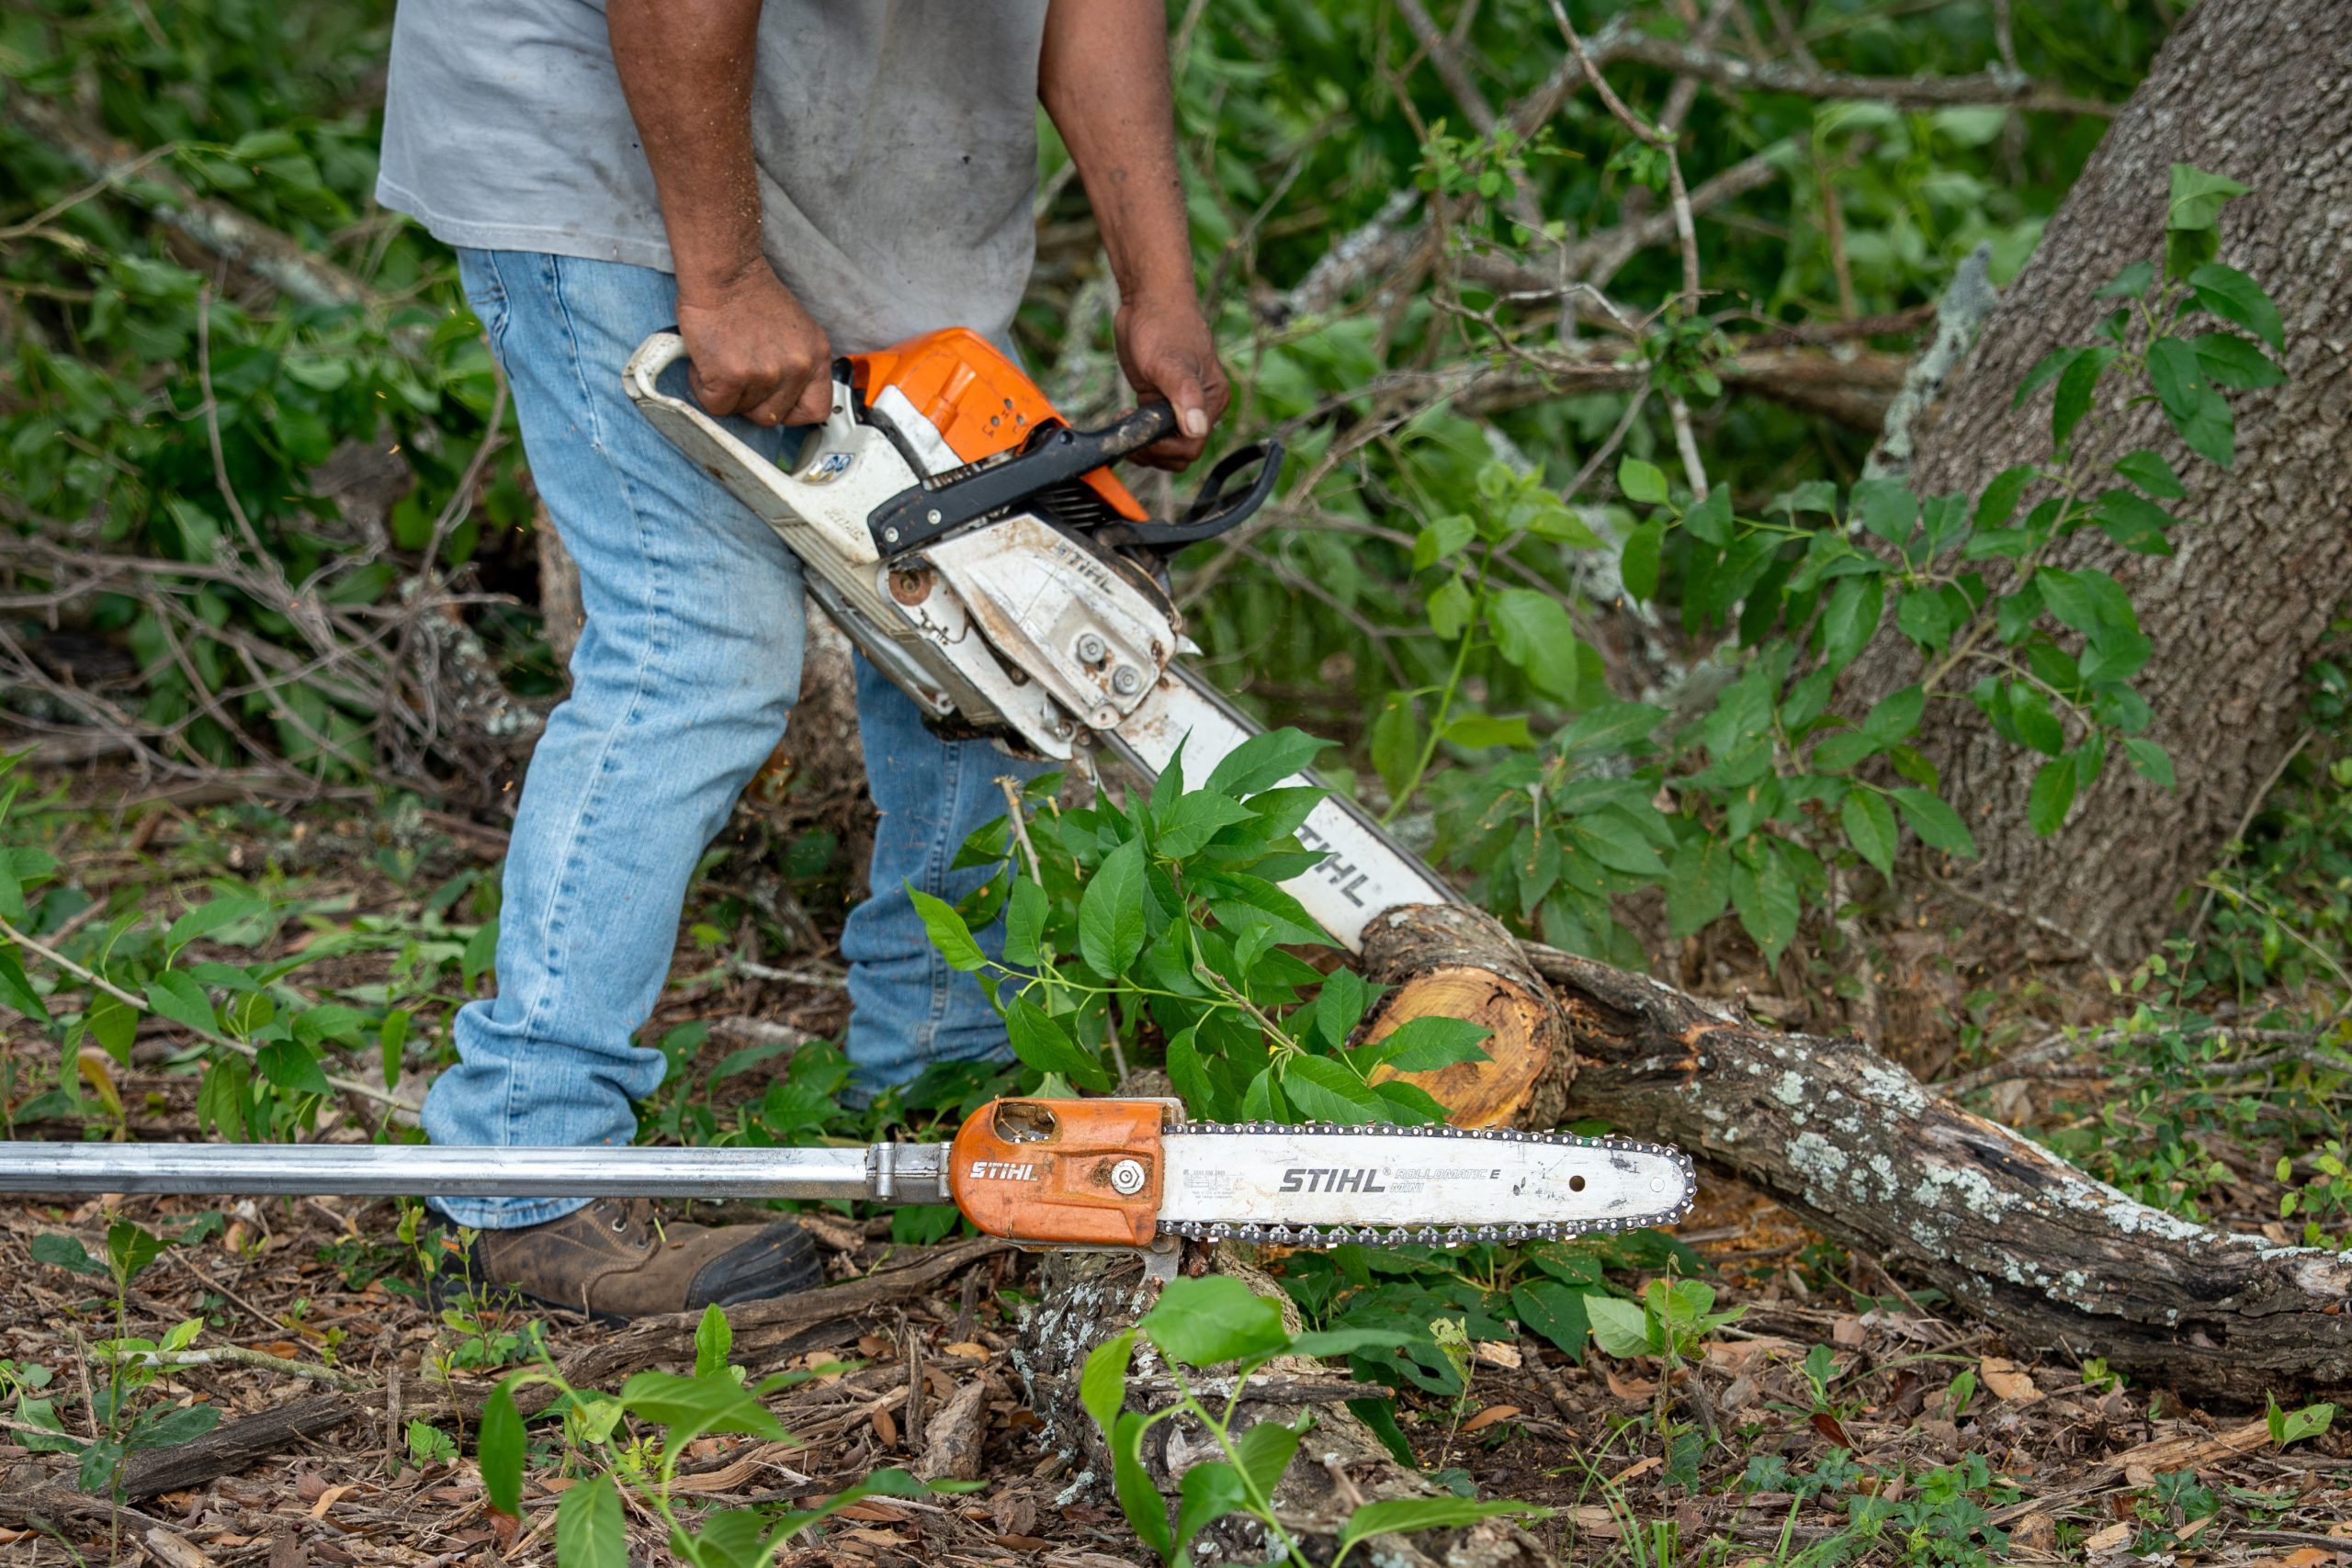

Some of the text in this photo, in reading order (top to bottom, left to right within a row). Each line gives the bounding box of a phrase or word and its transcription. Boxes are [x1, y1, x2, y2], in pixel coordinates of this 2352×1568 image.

[1056, 541, 1114, 596] STIHL
[969, 1161, 1038, 1181] STIHL
[1395, 1168, 1488, 1179] ROLLOMATIC
[1489, 1168, 1502, 1179] E
[1389, 1182, 1425, 1193] MINI
